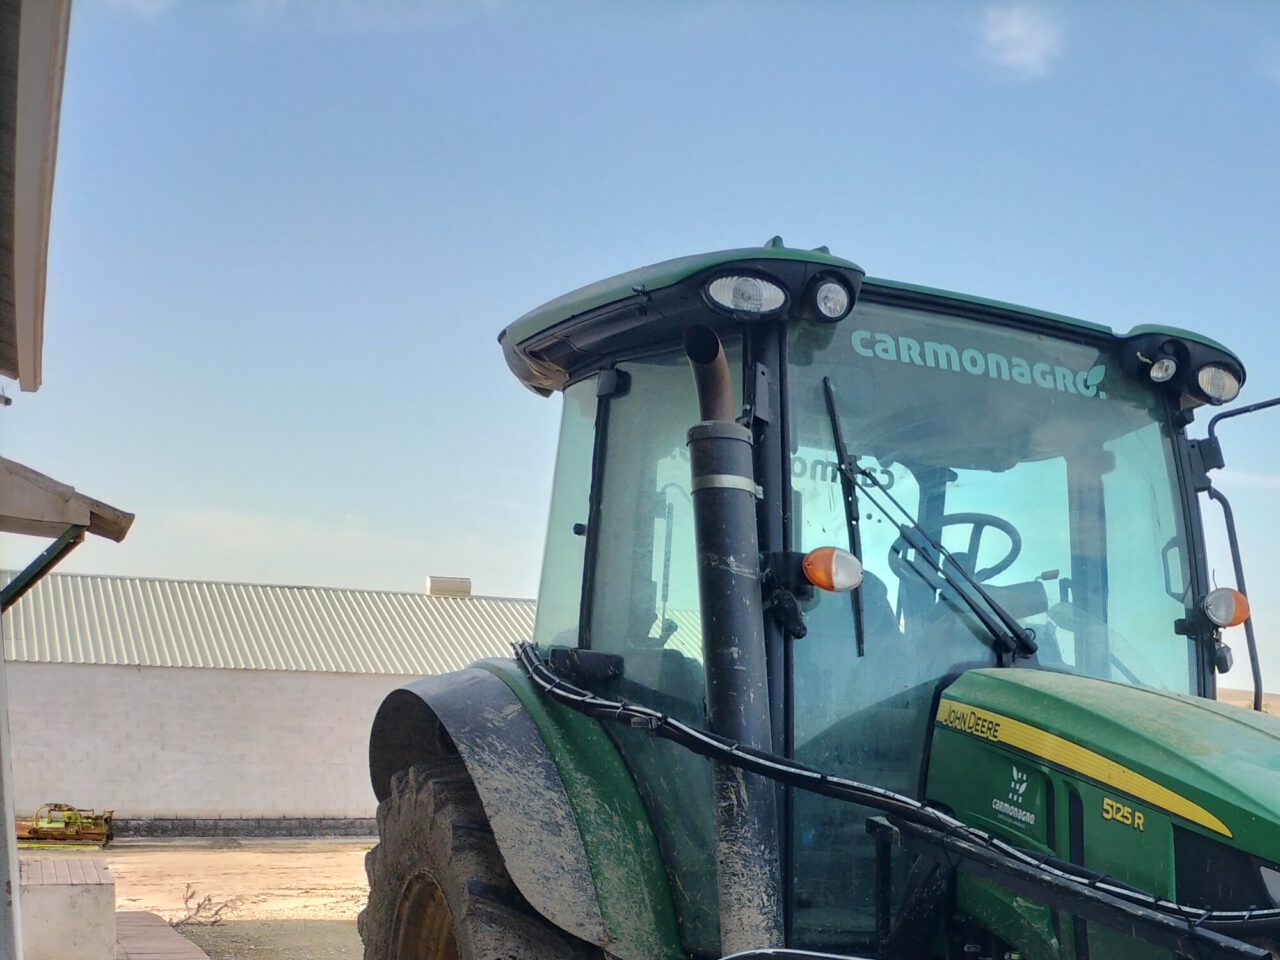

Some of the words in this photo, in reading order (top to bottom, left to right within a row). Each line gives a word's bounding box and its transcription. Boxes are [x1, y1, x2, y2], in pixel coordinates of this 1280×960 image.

[943, 704, 969, 731] JOHN
[967, 711, 1001, 740] DEERE
[1103, 796, 1132, 825] 5125
[1134, 811, 1145, 832] R
